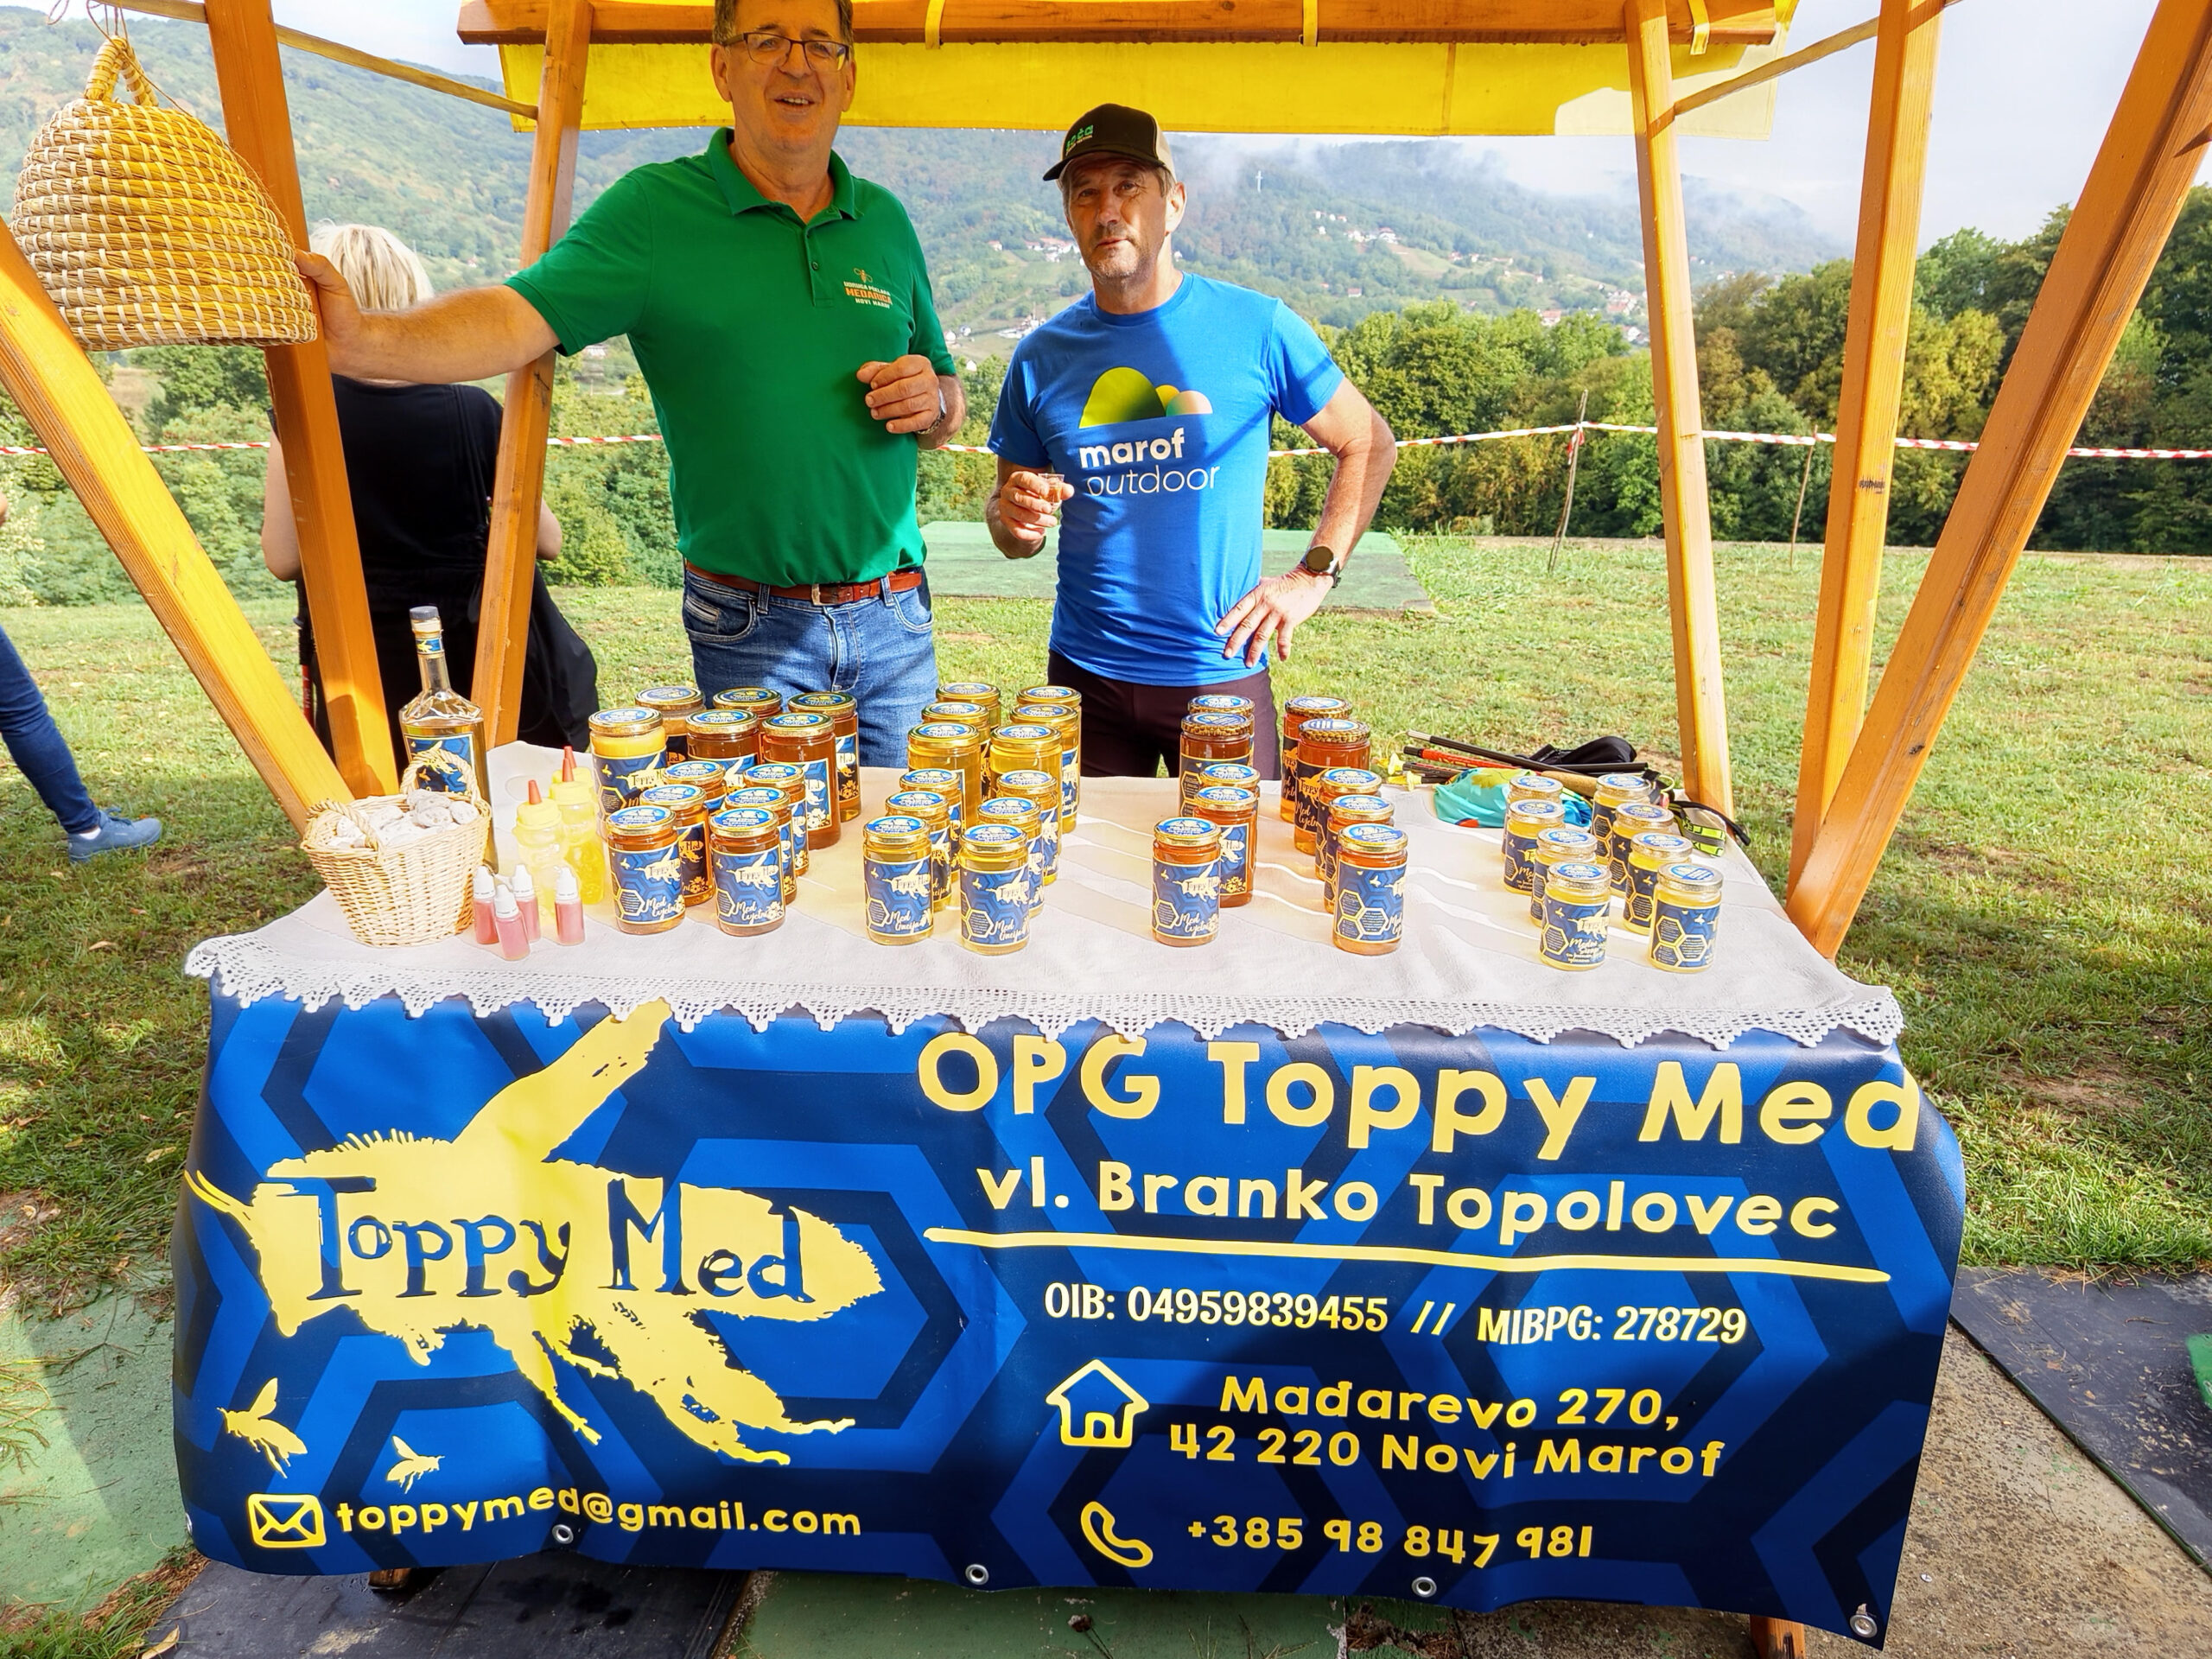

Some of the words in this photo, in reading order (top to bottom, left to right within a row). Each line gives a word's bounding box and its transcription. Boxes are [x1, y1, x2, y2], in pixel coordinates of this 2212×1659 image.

[845, 287, 893, 306] MEDARICA
[1079, 427, 1185, 469] marof
[1086, 464, 1221, 497] outdoor
[641, 896, 667, 913] Med
[734, 901, 757, 915] Med
[888, 912, 912, 925] Med
[1177, 912, 1201, 927] Med
[994, 918, 1015, 934] Med
[918, 1033, 1160, 1119] OPG
[1208, 1041, 1598, 1160] Toppy
[1638, 1061, 1921, 1152] Med
[977, 1157, 1069, 1209] vl.
[1099, 1160, 1378, 1221] Branko
[1409, 1174, 1840, 1246] Topolovec
[264, 1176, 571, 1300] Toppy
[598, 1177, 816, 1303] Med
[1045, 1282, 1116, 1319] OIB:
[1128, 1287, 1389, 1332] 04959839455
[1478, 1306, 1603, 1345] MIBPG:
[1613, 1306, 1747, 1344] 278729
[1556, 1388, 1679, 1431] 270,
[1170, 1423, 1236, 1462] 42
[1257, 1427, 1360, 1466] 220
[1382, 1433, 1516, 1480] Novi
[1533, 1439, 1726, 1477] Marof
[336, 1485, 861, 1535] toppymed@gmail.com
[1188, 1515, 1303, 1550] +385
[1324, 1519, 1382, 1552] 98
[1404, 1525, 1500, 1568] 847
[1516, 1525, 1593, 1558] 981
